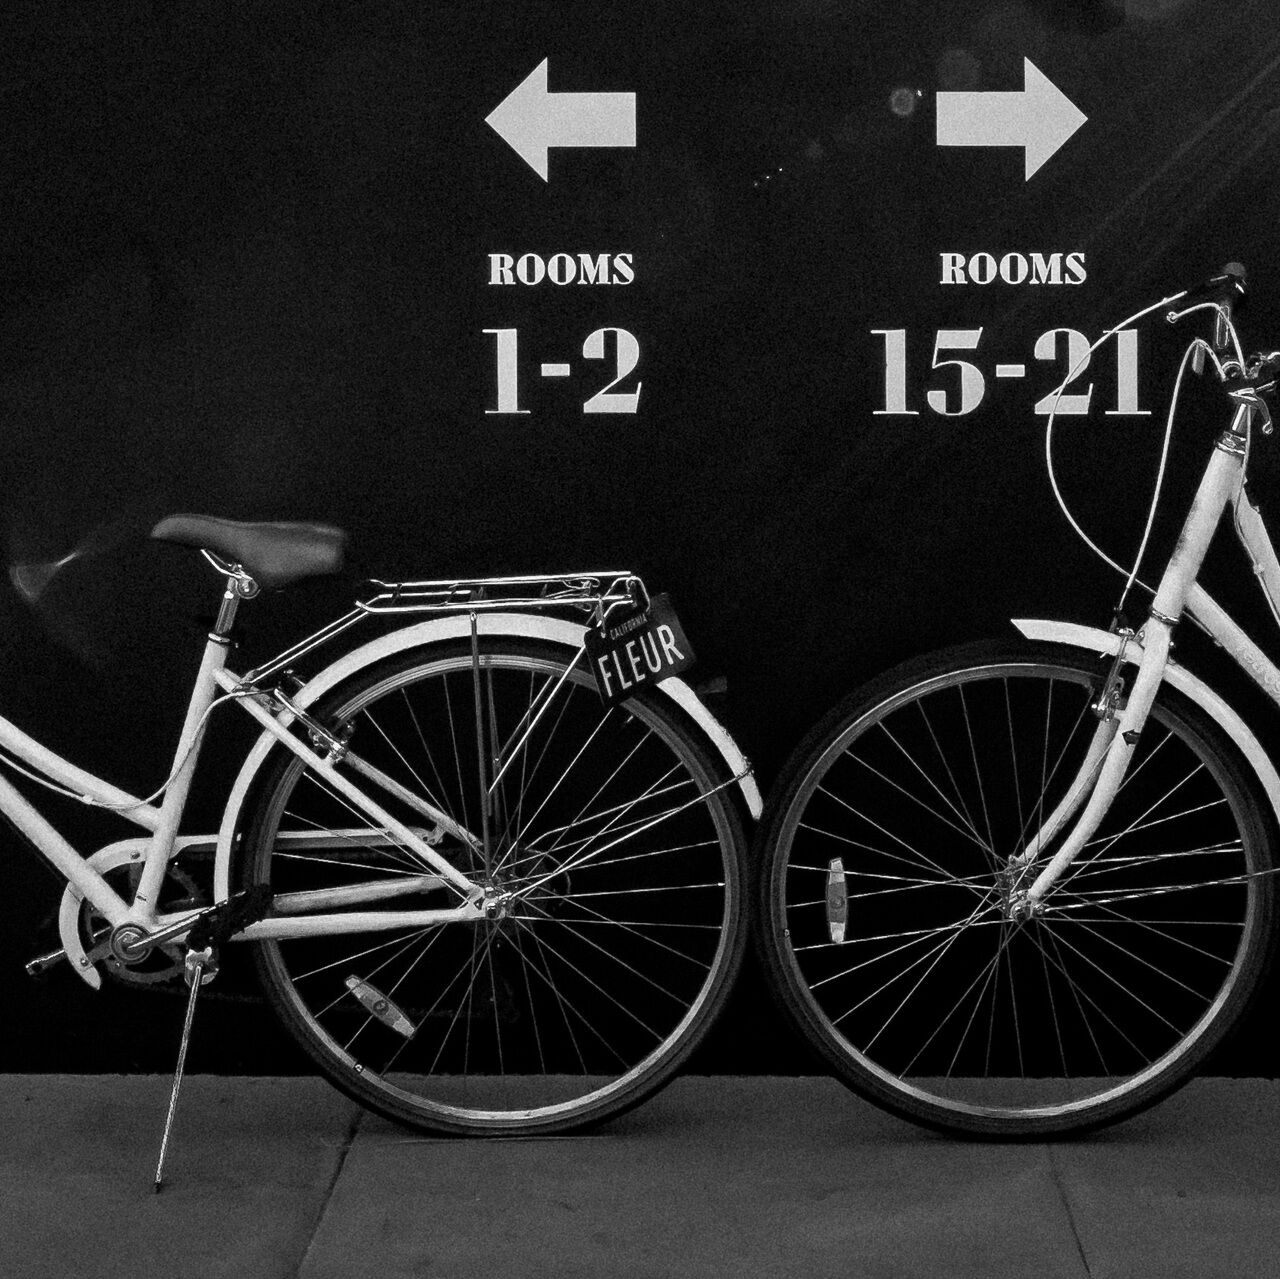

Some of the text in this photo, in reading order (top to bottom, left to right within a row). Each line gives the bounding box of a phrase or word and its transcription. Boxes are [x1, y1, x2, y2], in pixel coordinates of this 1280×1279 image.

[488, 252, 635, 286] ROOMS
[939, 252, 1087, 285] ROOMS
[482, 327, 642, 414] 1-2
[870, 326, 1152, 416] 15-21
[597, 624, 685, 697] FLEUR
